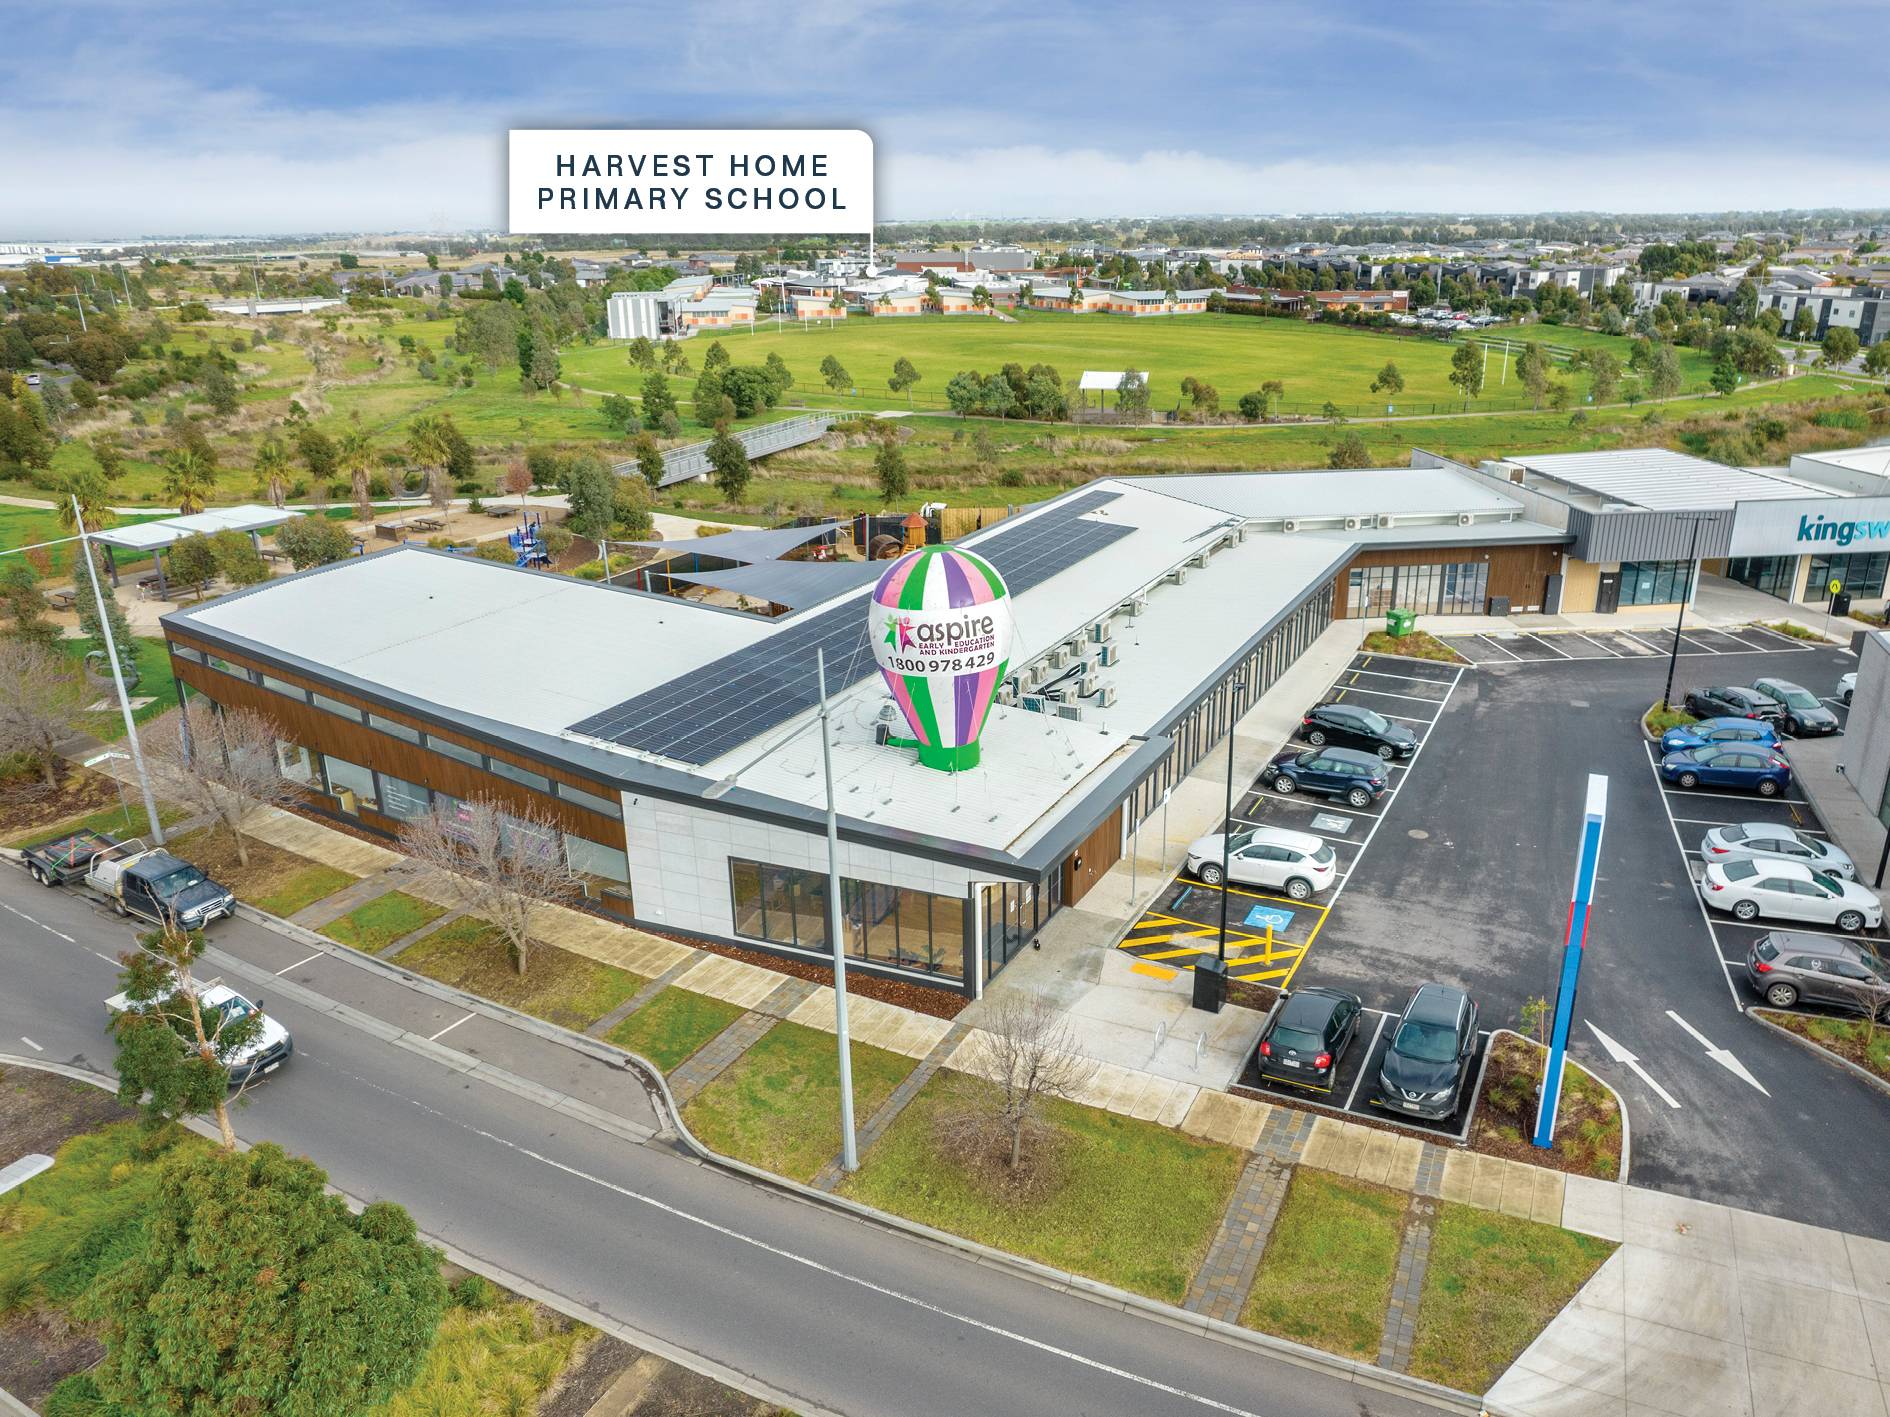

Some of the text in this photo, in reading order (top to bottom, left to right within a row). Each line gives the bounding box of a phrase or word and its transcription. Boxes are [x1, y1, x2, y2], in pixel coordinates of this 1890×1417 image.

[917, 614, 994, 646] aspire
[918, 634, 995, 650] EARLY EDUCATION
[919, 641, 995, 656] AND KINDERGARTEN
[888, 651, 995, 673] 1800 978 429
